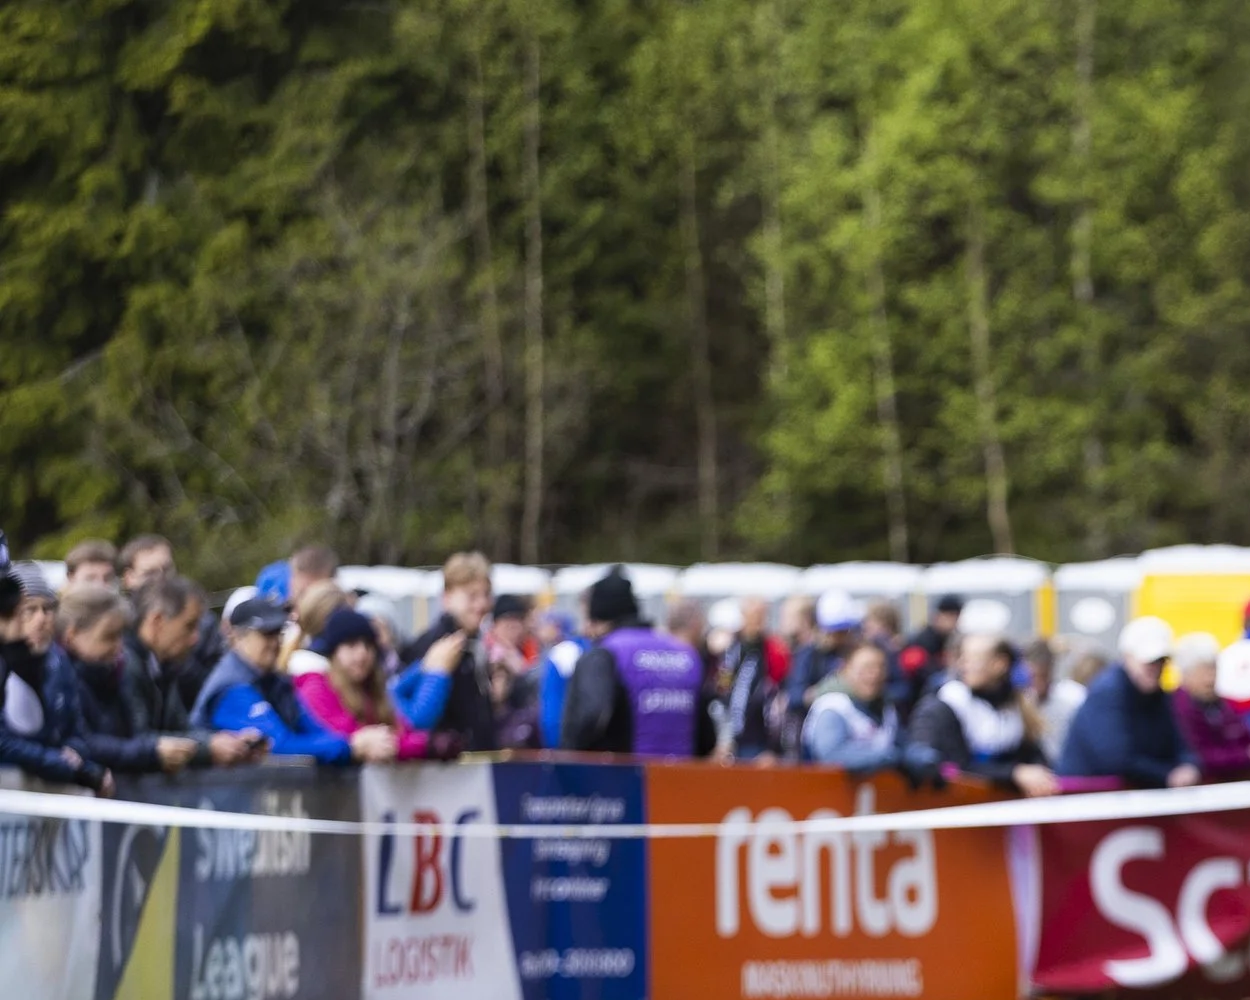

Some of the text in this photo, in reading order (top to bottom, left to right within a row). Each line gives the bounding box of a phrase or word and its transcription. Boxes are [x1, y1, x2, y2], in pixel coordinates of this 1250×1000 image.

[376, 808, 481, 917] LBC
[715, 783, 939, 939] renta
[374, 932, 474, 989] LOGISTIK
